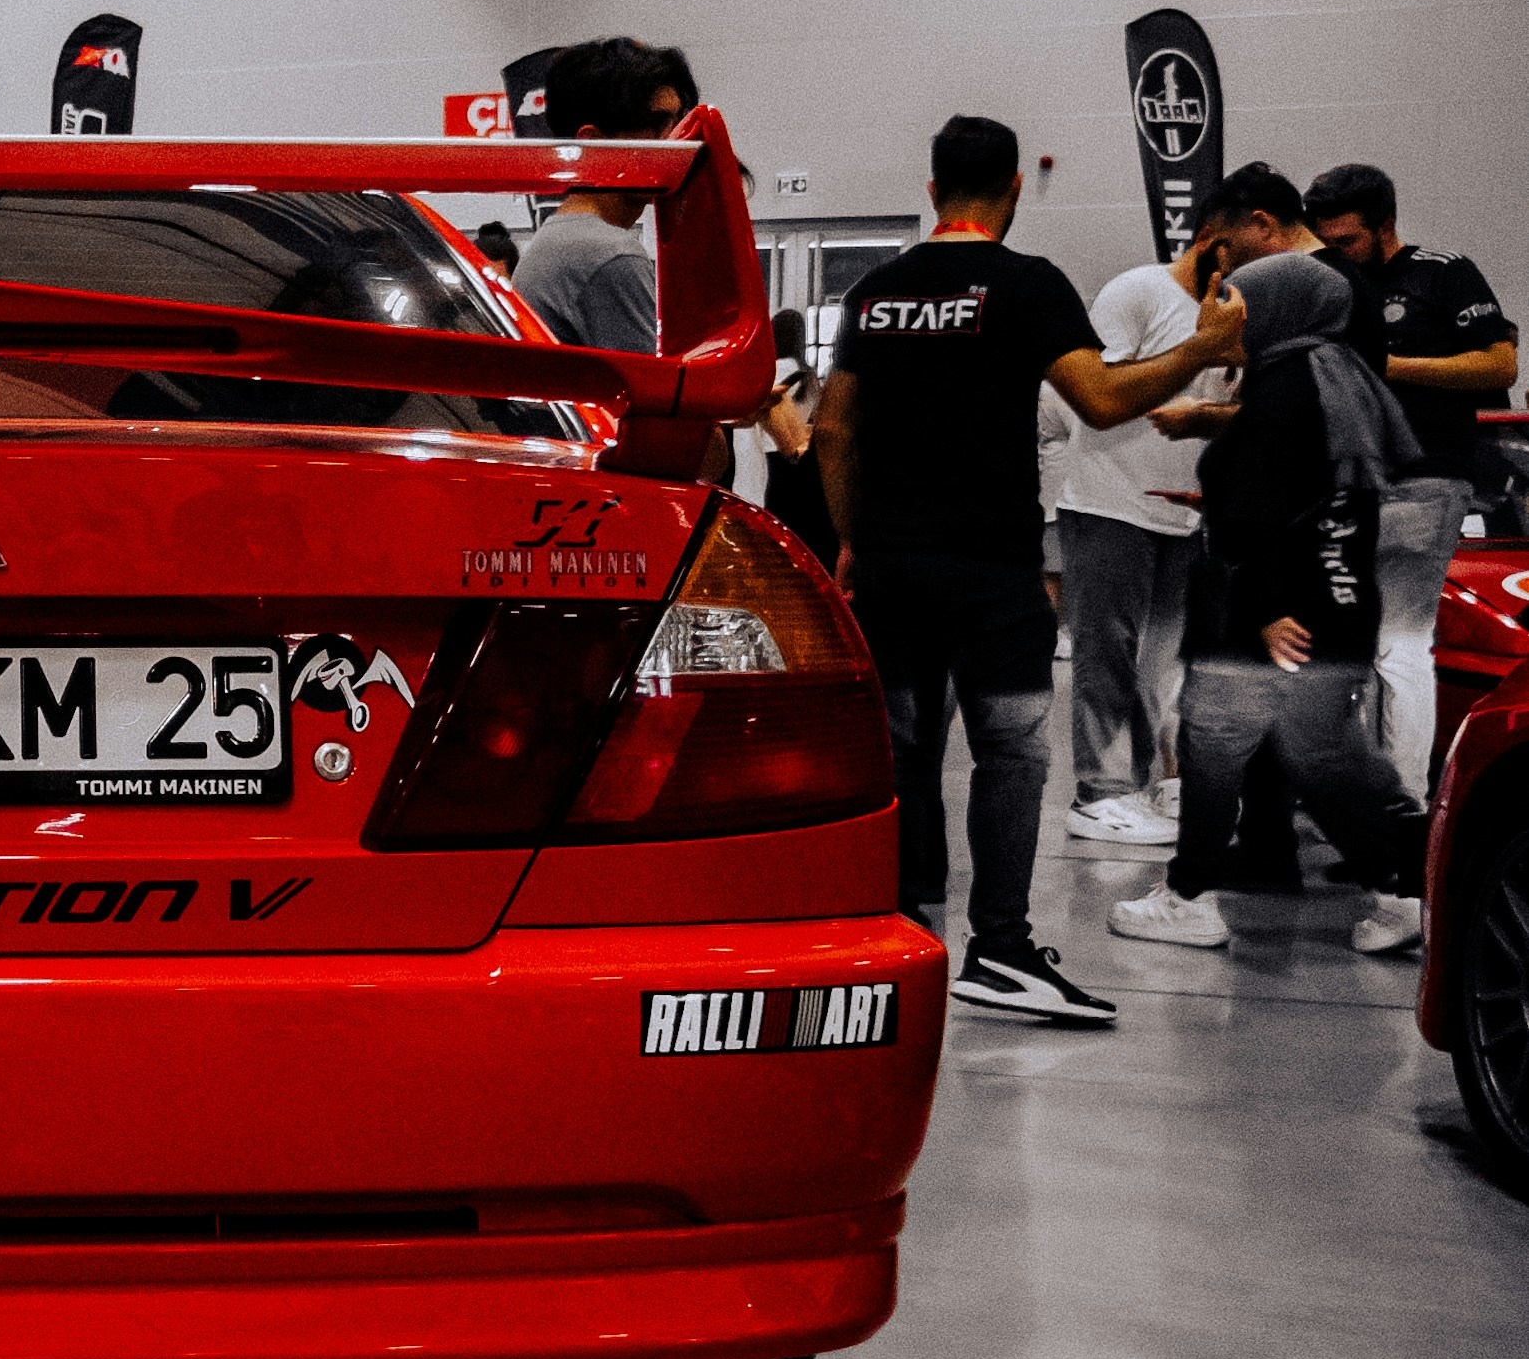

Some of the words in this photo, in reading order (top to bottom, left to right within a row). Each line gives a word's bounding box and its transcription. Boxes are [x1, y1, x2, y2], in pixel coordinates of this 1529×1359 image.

[462, 550, 533, 574] TOMMI
[549, 550, 647, 574] MAKINEN
[461, 575, 647, 589] EDITION
[146, 656, 275, 759] 25
[76, 779, 153, 796] TOMMI
[159, 779, 263, 796] MAKINEN
[645, 991, 765, 1054] RALLI
[820, 984, 893, 1046] ART
